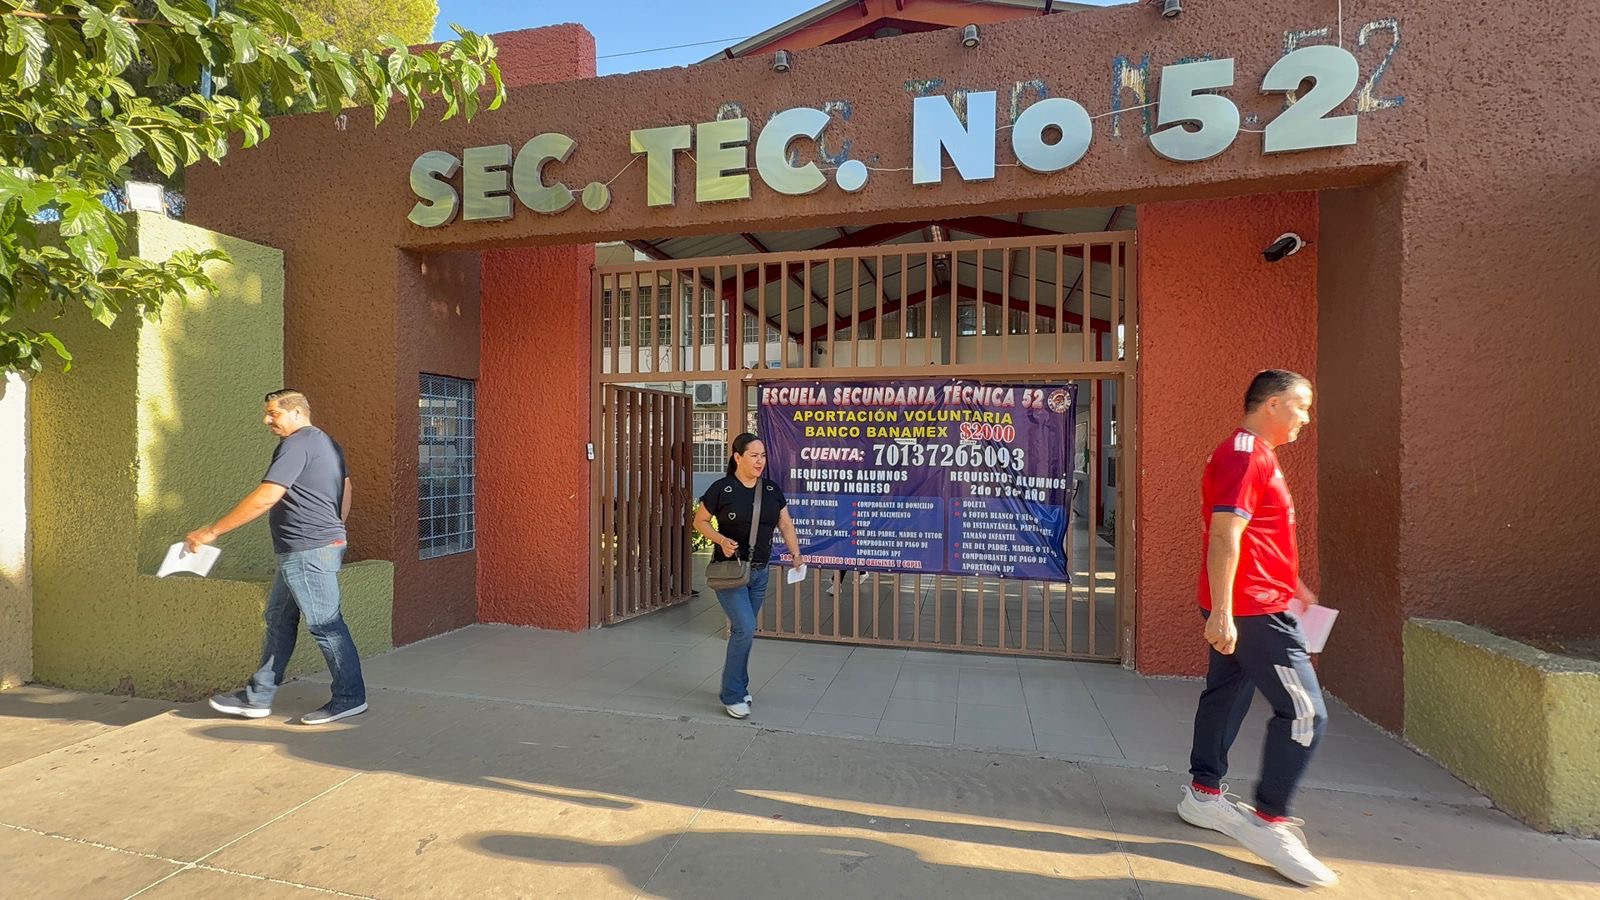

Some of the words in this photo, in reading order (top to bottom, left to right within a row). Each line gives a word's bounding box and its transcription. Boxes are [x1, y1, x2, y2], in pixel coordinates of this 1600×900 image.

[407, 133, 611, 229] SEC.
[630, 107, 869, 207] TEC.
[912, 90, 1093, 185] No
[1149, 45, 1360, 163] 52
[762, 386, 828, 406] ESCUELA
[833, 386, 937, 406] SECUNDARIA
[942, 380, 1015, 407] TÉCNICA
[1021, 388, 1044, 409] 52
[793, 408, 897, 422] APORTACIÓN
[904, 410, 1013, 424] VOLUNTARIA
[805, 426, 860, 437] BANCO
[866, 426, 948, 438] BANAMEX
[959, 421, 1015, 444] $2000
[801, 447, 865, 462] CUENTA:
[872, 444, 1025, 471] 70137265093
[790, 468, 853, 480] REQUISITOS
[856, 470, 908, 481] ALUMNOS
[806, 481, 840, 492] NUEVO
[844, 482, 891, 493] INGRESO
[1016, 475, 1066, 489] ALUMNOS
[970, 484, 991, 495] 2do
[995, 486, 1001, 496] y
[1024, 488, 1046, 501] AÑO
[810, 499, 838, 507] PRIMARIA
[857, 501, 896, 509] COMPROBANTE
[905, 502, 934, 510] DOMICILIO
[880, 511, 911, 519] NACIMIENTO
[968, 511, 989, 519] FOTOS
[990, 512, 1014, 520] BLANCO
[962, 531, 987, 539] TAMAÑO
[988, 532, 1016, 541] INFANTIL
[921, 541, 928, 549] DE
[1012, 544, 1034, 552] MADRE
[866, 558, 896, 567] ORIGINAL
[962, 553, 1007, 562] COMPROBANTE
[1008, 554, 1018, 563] DE
[1019, 555, 1037, 564] PAGO
[1038, 556, 1047, 564] DE
